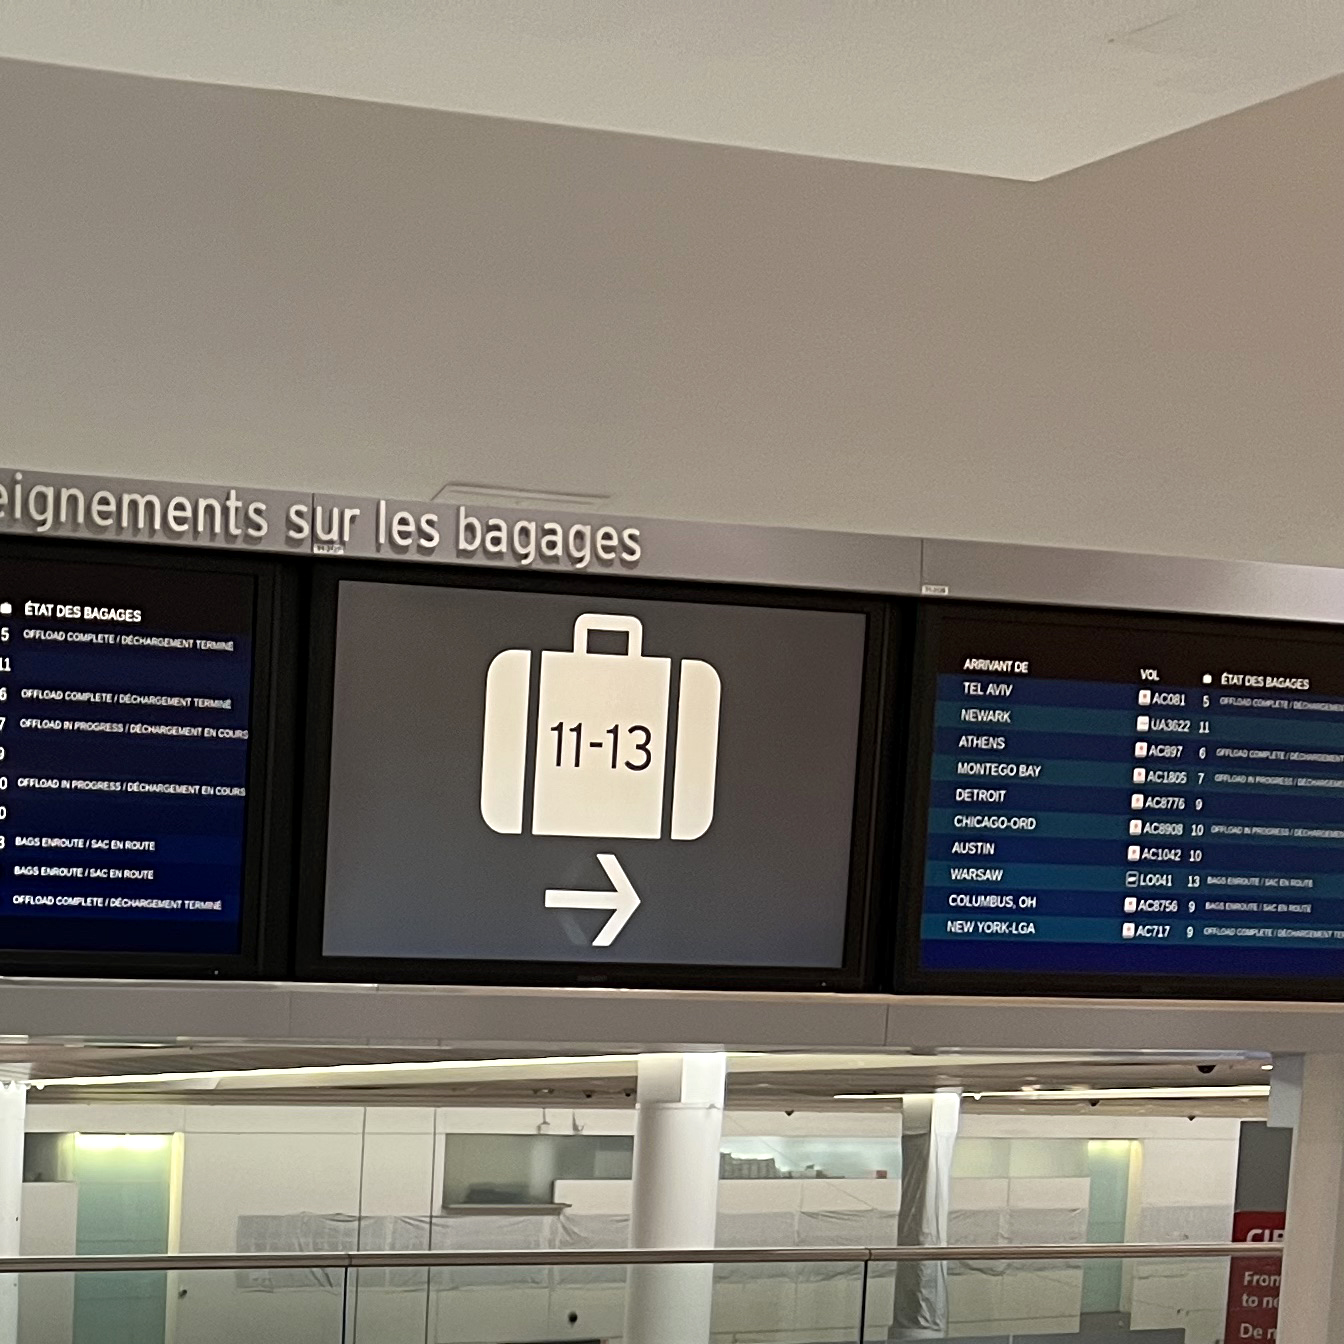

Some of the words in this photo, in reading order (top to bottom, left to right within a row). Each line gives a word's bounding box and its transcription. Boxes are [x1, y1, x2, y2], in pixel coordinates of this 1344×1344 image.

[286, 497, 360, 546] sur
[376, 498, 442, 551] les
[457, 505, 642, 570] bagages
[25, 600, 54, 617] ÉTAT
[56, 604, 81, 618] DES
[84, 606, 141, 622] BAGAGES
[963, 682, 984, 695] TEL
[986, 683, 1013, 696] AVIV
[1152, 692, 1185, 706] AC081
[961, 709, 1011, 723] NEWARK
[549, 721, 652, 772] 11-13
[958, 735, 1005, 749] ATHENS
[956, 788, 1006, 802] DETROIT
[952, 842, 995, 855] AUSTIN
[1241, 1292, 1259, 1308] to
[1240, 1323, 1262, 1340] De
